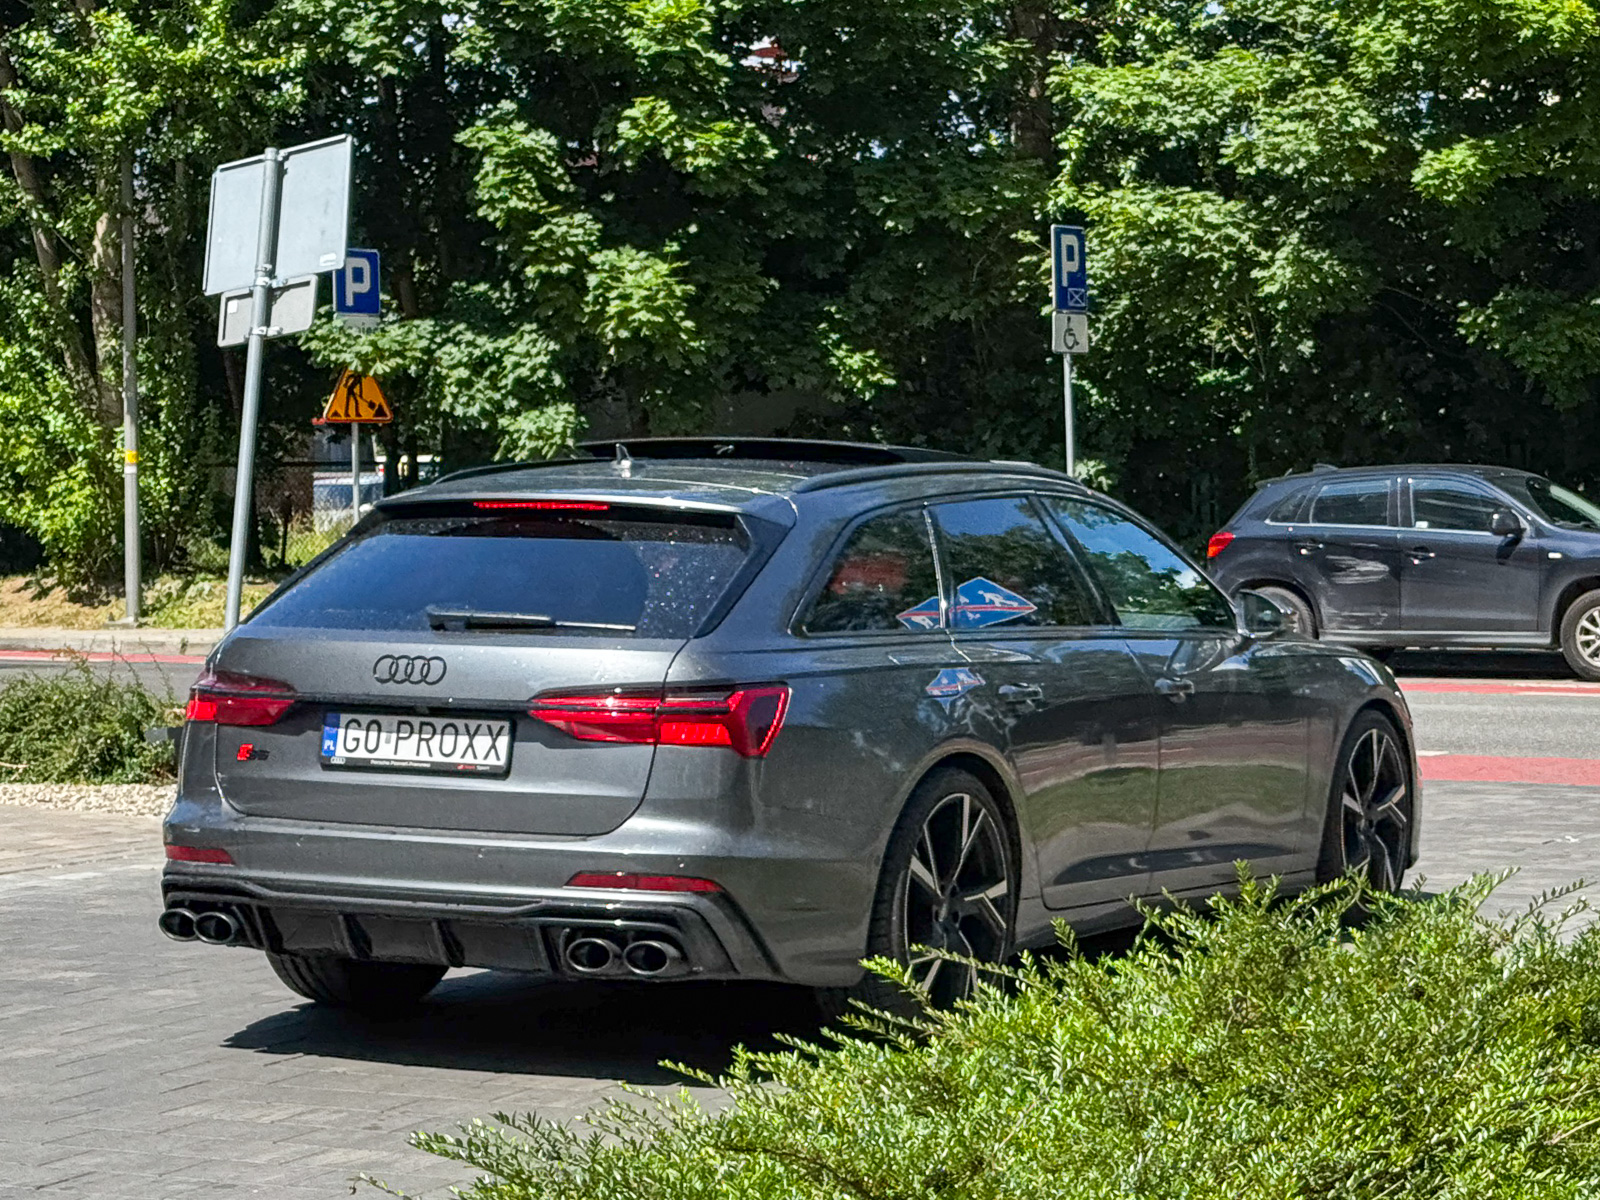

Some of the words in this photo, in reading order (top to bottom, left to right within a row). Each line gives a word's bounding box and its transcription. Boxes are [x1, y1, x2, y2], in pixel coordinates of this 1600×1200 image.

[344, 257, 372, 307] P
[1060, 233, 1080, 288] P
[324, 739, 336, 751] PL
[343, 717, 383, 755] GO
[393, 719, 505, 762] PROXX
